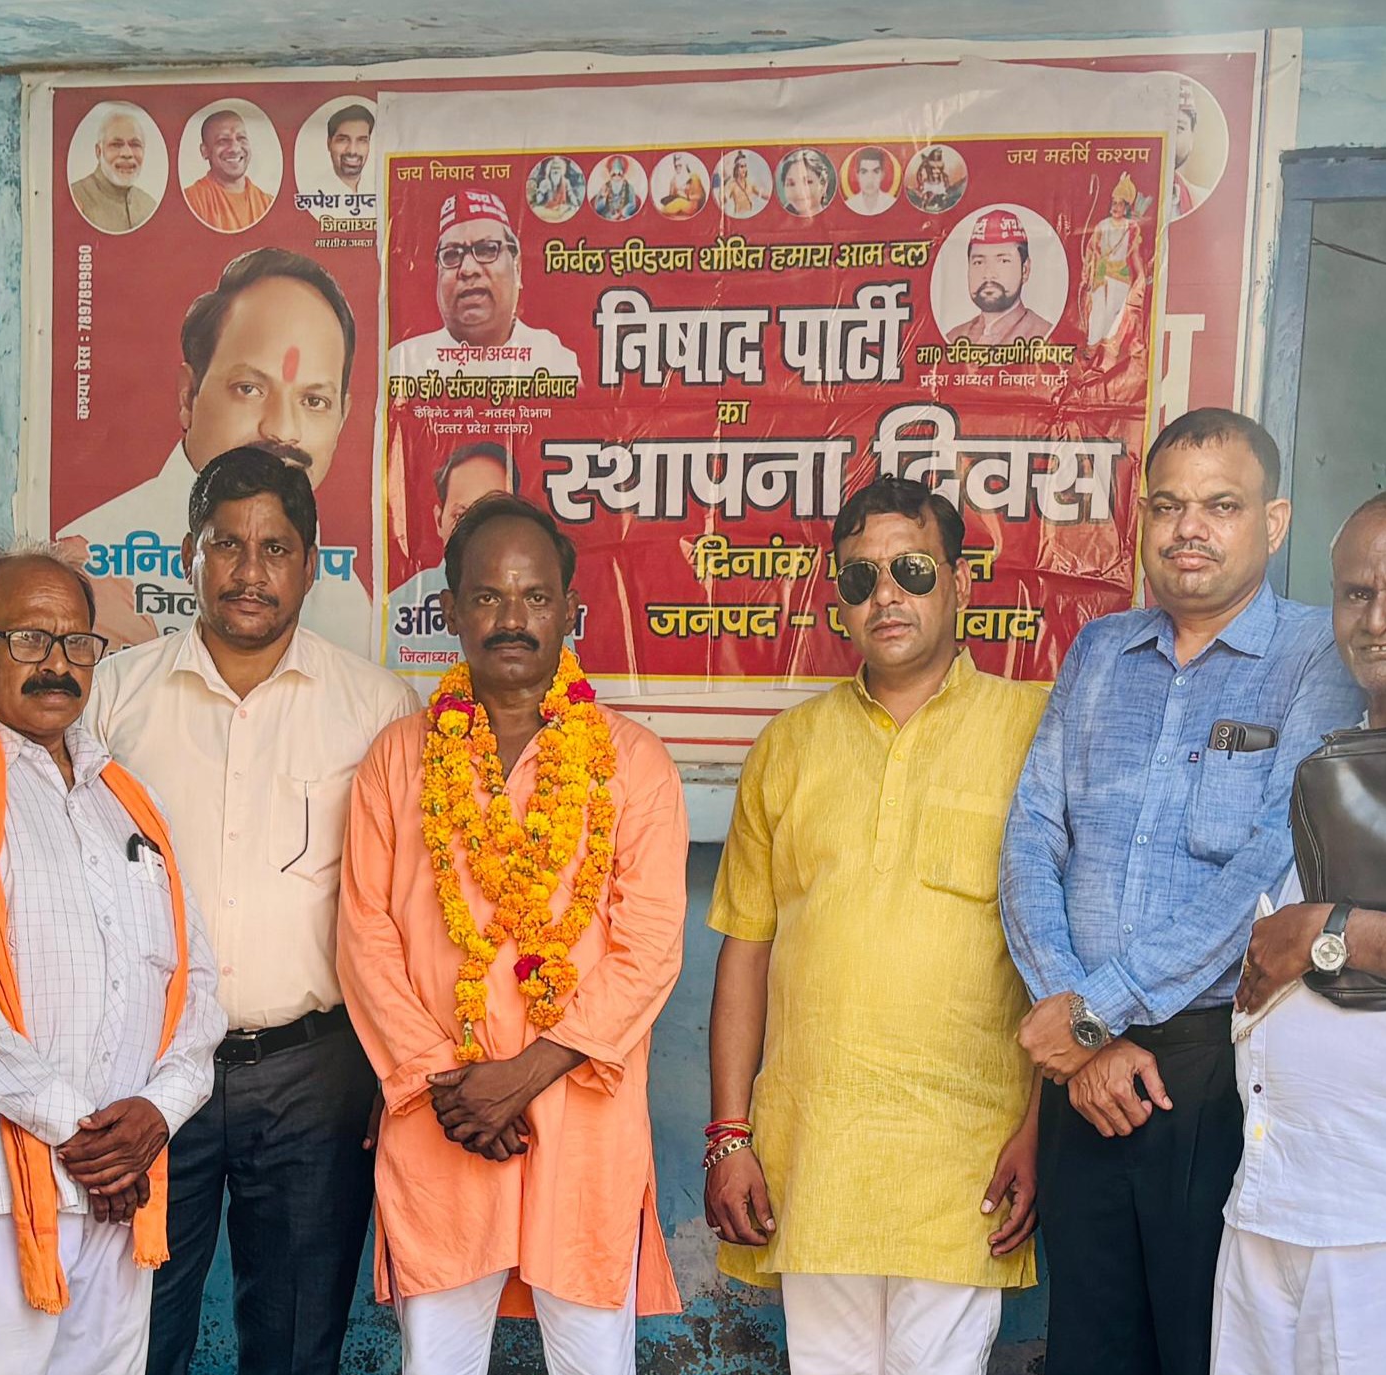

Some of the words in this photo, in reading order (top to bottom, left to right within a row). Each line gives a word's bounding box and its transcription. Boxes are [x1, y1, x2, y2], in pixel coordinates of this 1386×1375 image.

[1007, 149, 1037, 165] जय
[1044, 142, 1092, 165] महर्षि
[1097, 147, 1151, 164] कश्यप
[397, 166, 424, 181] जय
[430, 160, 475, 181] निषाद
[481, 164, 511, 180] राज
[610, 239, 694, 275] इण्डियन
[699, 236, 764, 272] शोषित
[770, 243, 831, 270] हमारा
[836, 242, 884, 269] आम
[890, 240, 931, 268] दल
[77, 245, 93, 332] 7897899860
[595, 287, 769, 384] निषाद
[779, 282, 910, 383] पार्टी
[437, 342, 481, 366] राष्ट्रीय
[487, 346, 532, 362] अध्यक्ष
[1028, 337, 1076, 364] निषाद
[446, 370, 489, 398] संजय
[490, 376, 532, 406] कुमार
[534, 368, 578, 398] निषाद
[953, 374, 994, 387] अध्यक्ष
[998, 369, 1037, 387] निषाद
[1040, 369, 1069, 387] पार्टी
[76, 376, 90, 421] कश्यप
[519, 405, 552, 419] विभाग
[717, 399, 751, 425] का
[467, 420, 490, 434] प्रदेश
[543, 438, 853, 520] स्थापना
[694, 535, 816, 580] दिनांक
[647, 605, 781, 639] जनपद
[399, 645, 460, 664] जिलाध्यक्ष
